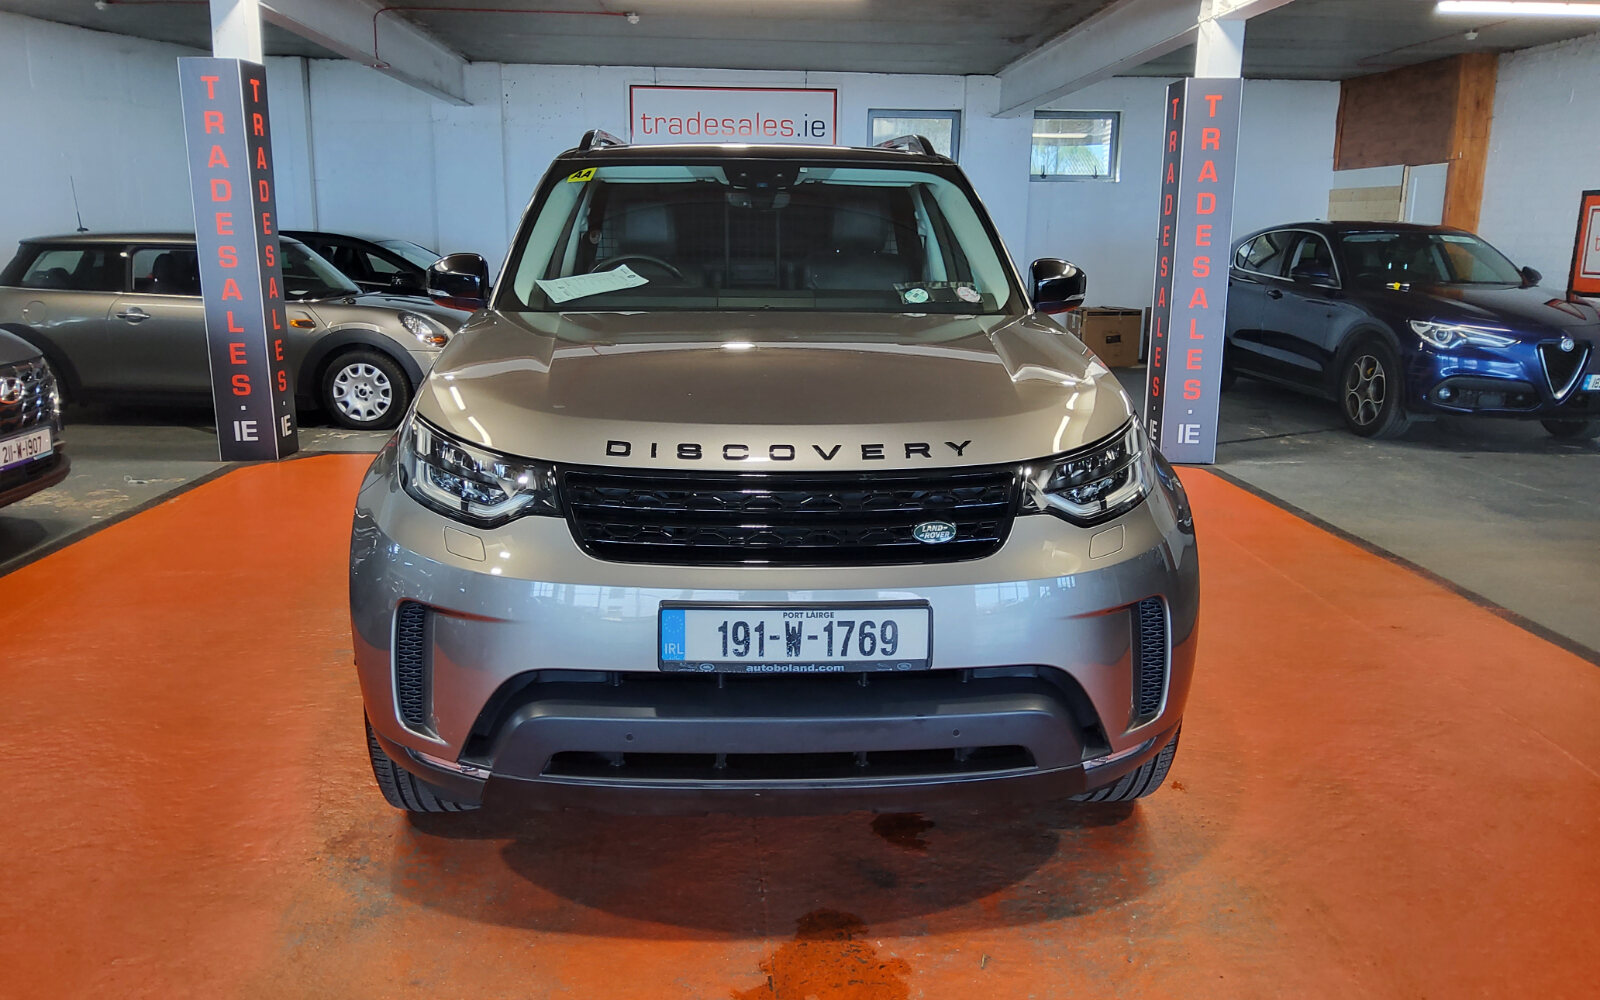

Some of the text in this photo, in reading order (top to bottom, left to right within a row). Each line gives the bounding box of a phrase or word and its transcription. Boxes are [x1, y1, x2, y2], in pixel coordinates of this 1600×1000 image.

[641, 111, 826, 138] tradesales.ie
[571, 170, 592, 179] AA
[605, 440, 972, 461] DISCOVERY
[924, 531, 950, 539] ROVER
[718, 620, 899, 658] 191-W-1769
[664, 643, 685, 655] IRL
[745, 664, 845, 673] autoboland.com
